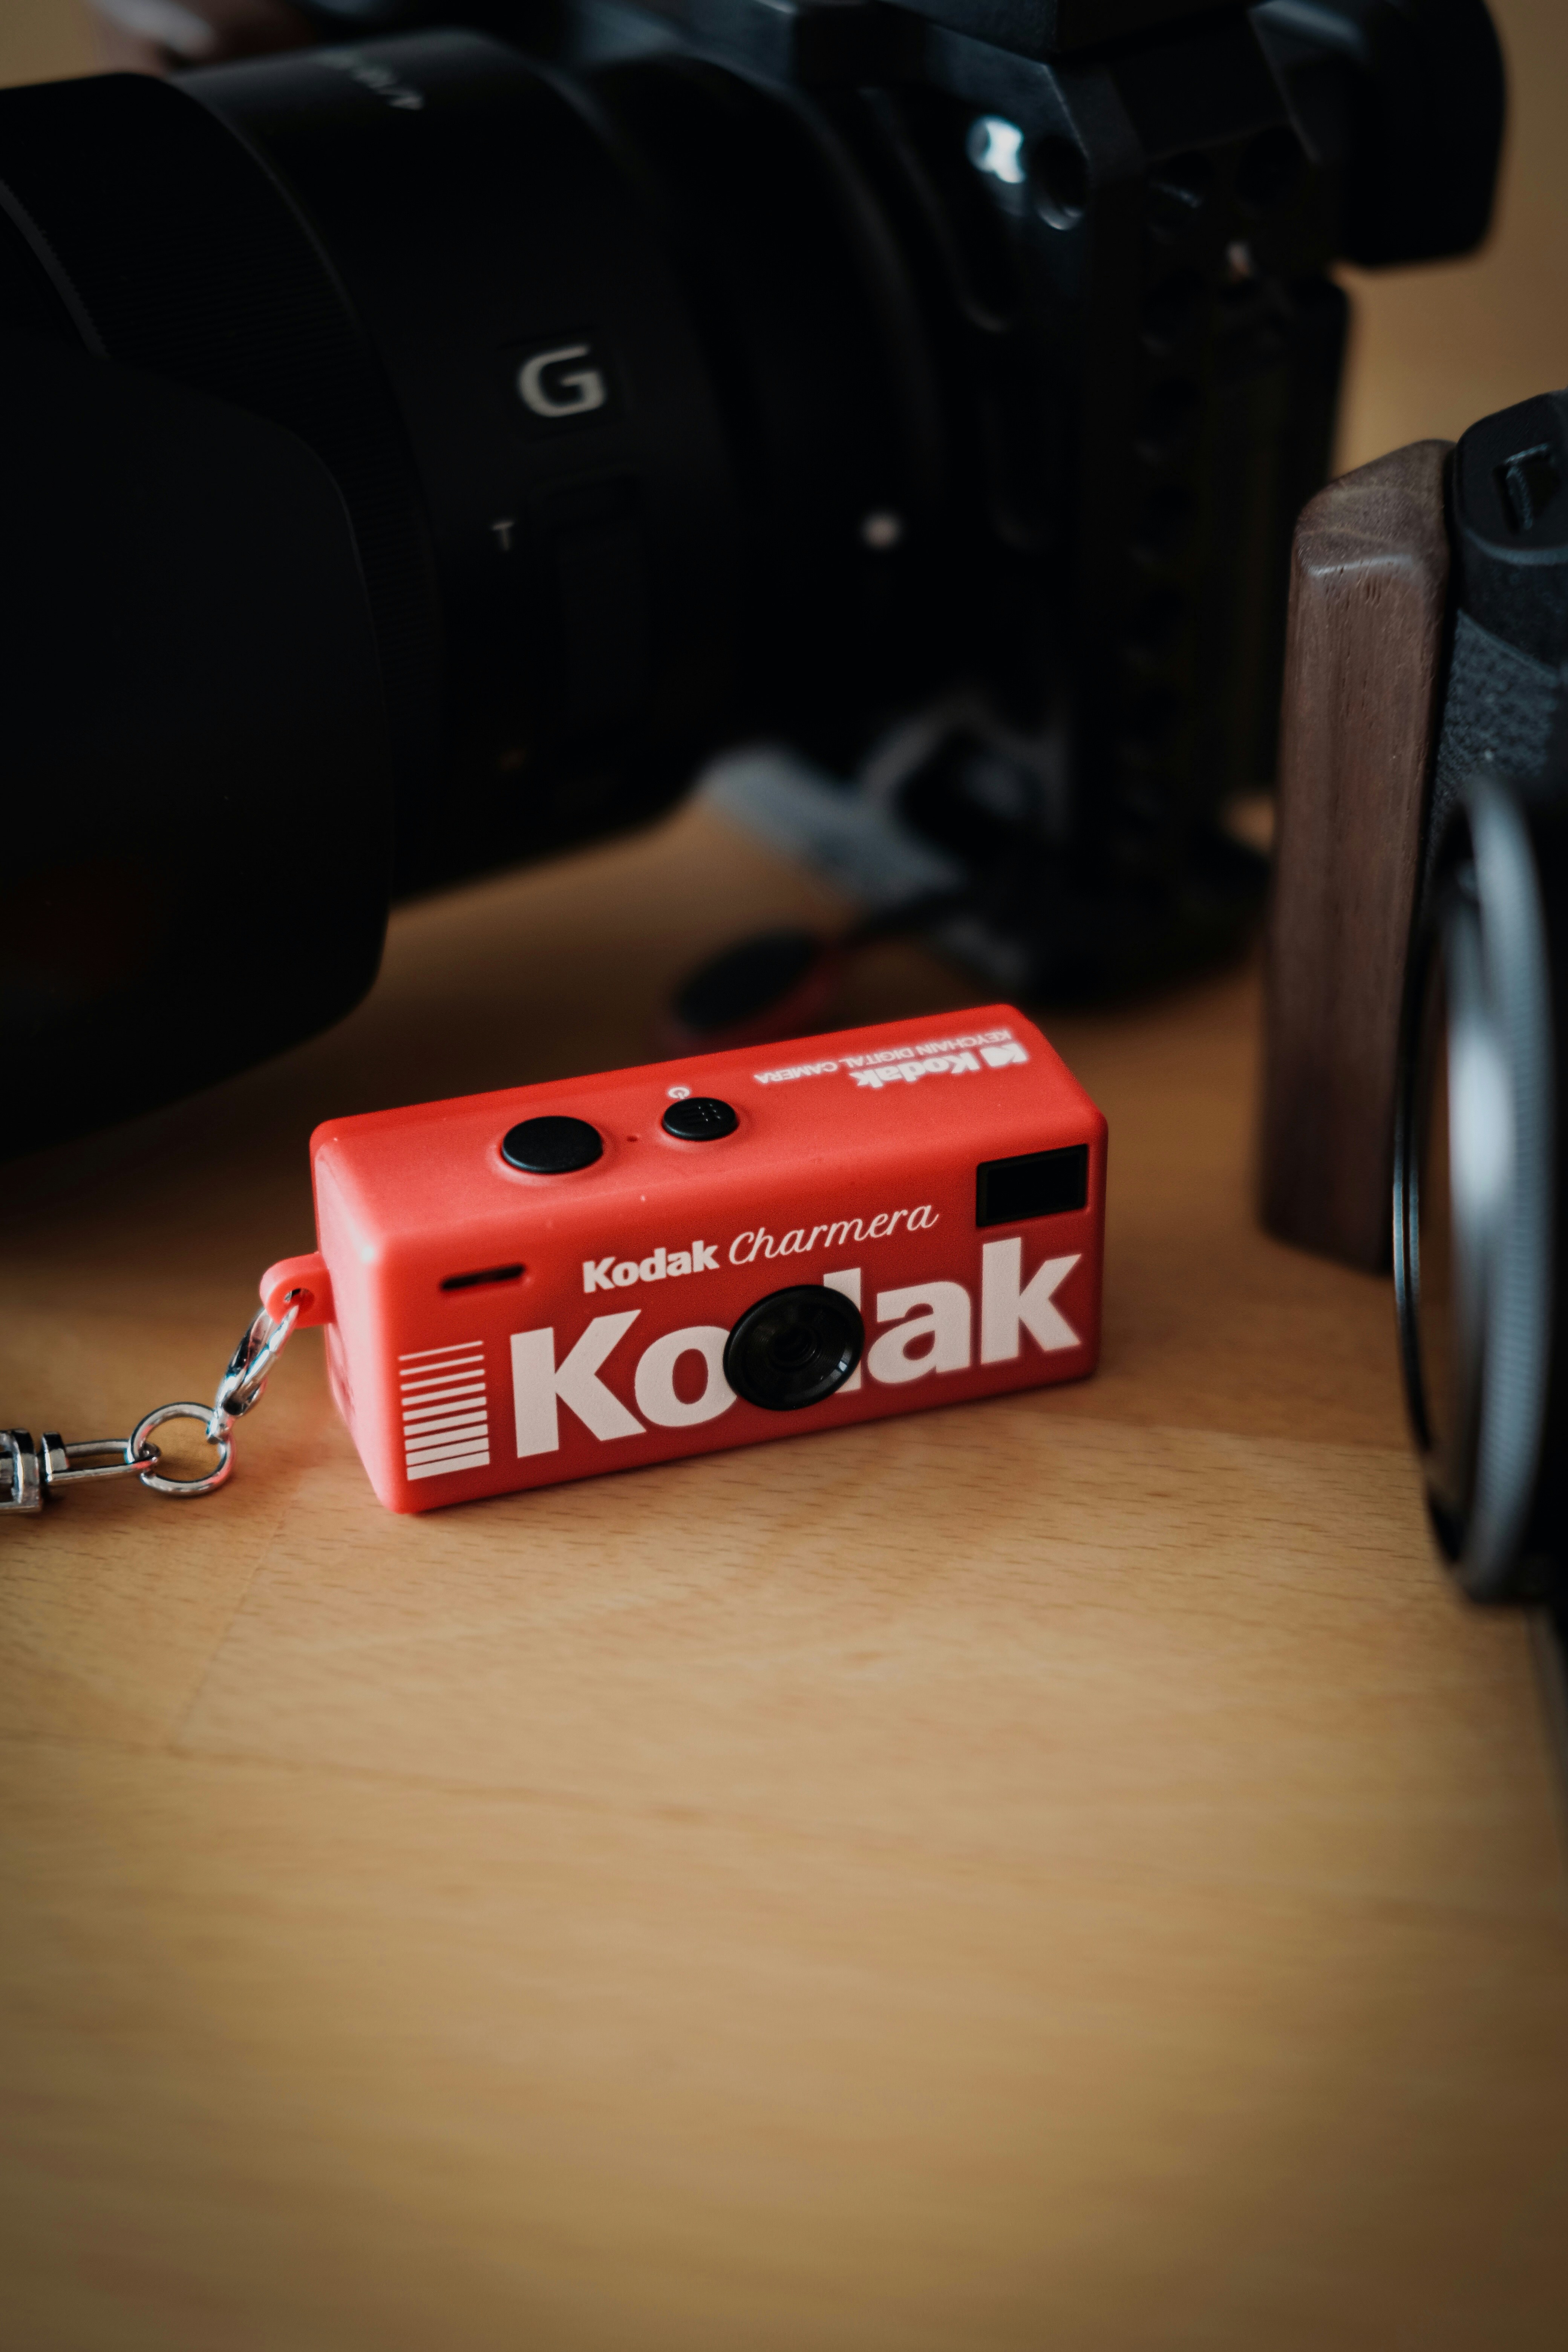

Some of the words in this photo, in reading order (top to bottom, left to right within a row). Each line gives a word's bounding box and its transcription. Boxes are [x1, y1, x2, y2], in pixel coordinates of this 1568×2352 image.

[516, 341, 609, 419] G
[839, 1047, 913, 1069] DIGITAL
[917, 1029, 1013, 1056] KEYCHAIN
[754, 1061, 838, 1084] CAMERA
[849, 1051, 980, 1088] Kodak
[583, 1240, 720, 1293] Kodak
[728, 1205, 939, 1265] Charmera
[510, 1237, 1082, 1458] Koak
